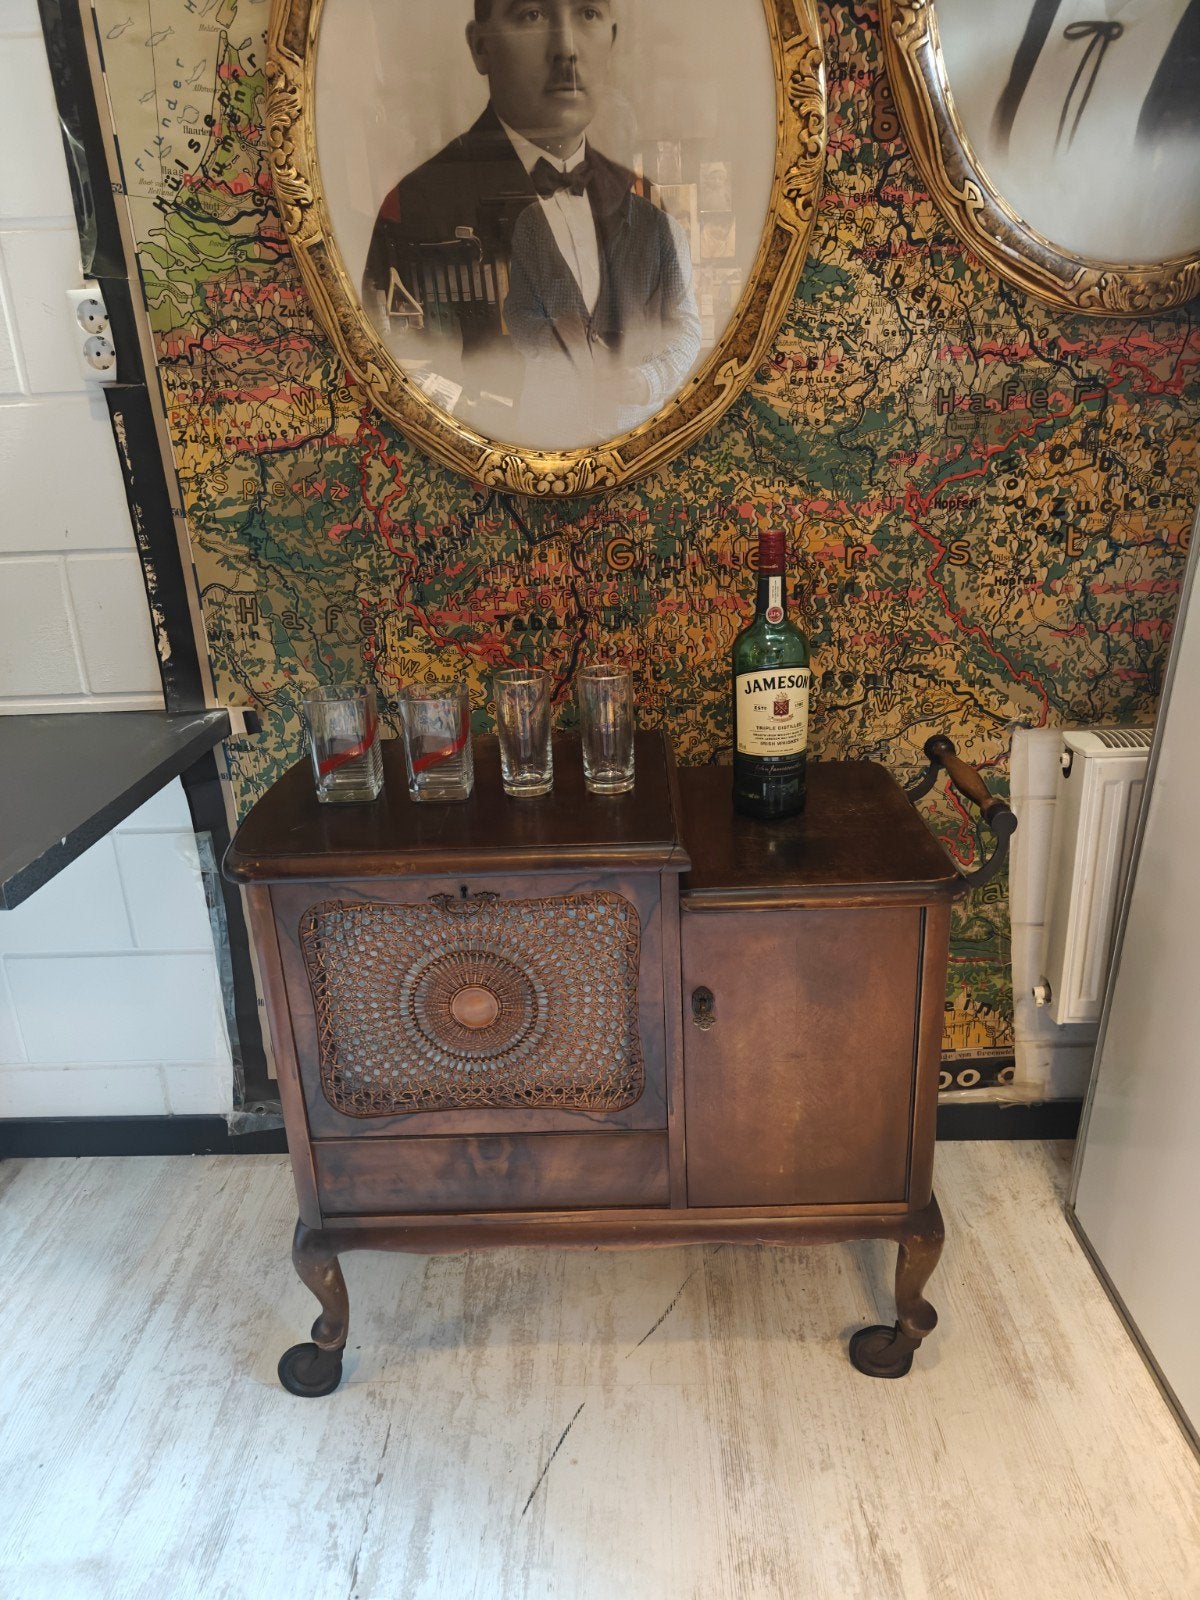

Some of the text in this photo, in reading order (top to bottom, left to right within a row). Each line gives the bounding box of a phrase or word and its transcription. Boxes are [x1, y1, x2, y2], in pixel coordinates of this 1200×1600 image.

[134, 57, 184, 172] Flunder
[278, 303, 315, 320] Zuck
[166, 377, 234, 394] Hopfen
[936, 380, 1097, 417] Hafer
[177, 424, 303, 448] Zuckerrüben
[211, 472, 346, 502] Spelz
[238, 596, 422, 638] Hafer
[599, 644, 696, 660] Hopfen
[744, 674, 810, 695] JAMESON
